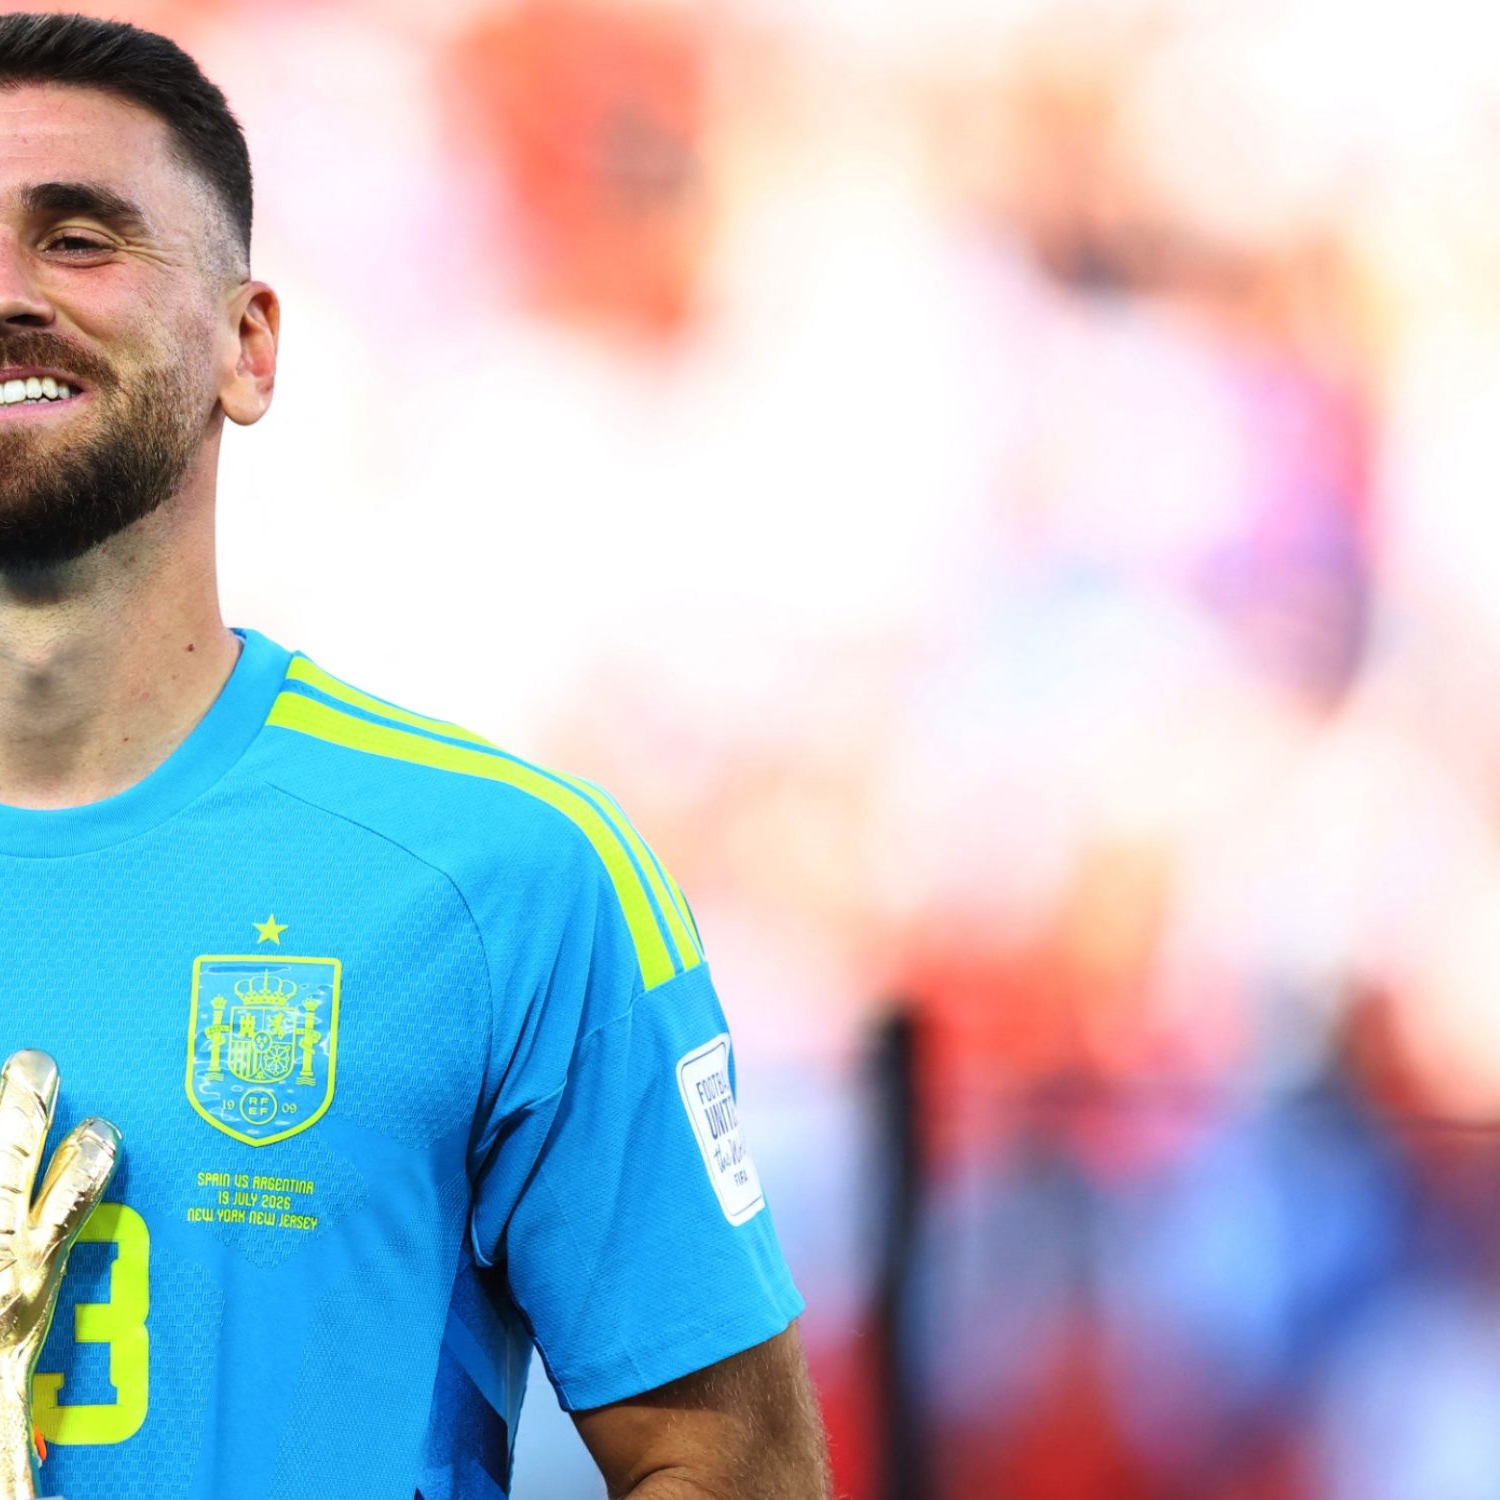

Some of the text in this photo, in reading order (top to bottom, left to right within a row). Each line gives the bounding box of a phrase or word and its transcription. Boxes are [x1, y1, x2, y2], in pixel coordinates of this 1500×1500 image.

[222, 1099, 297, 1114] 19 09
[704, 1096, 740, 1141] UNITE
[197, 1172, 231, 1188] SPAIN
[252, 1175, 315, 1195] ARGENTINA
[733, 1169, 749, 1188] FIFA
[218, 1190, 292, 1210] 19 JULY 2026
[187, 1207, 318, 1231] NEW YORK NEW JERSEY
